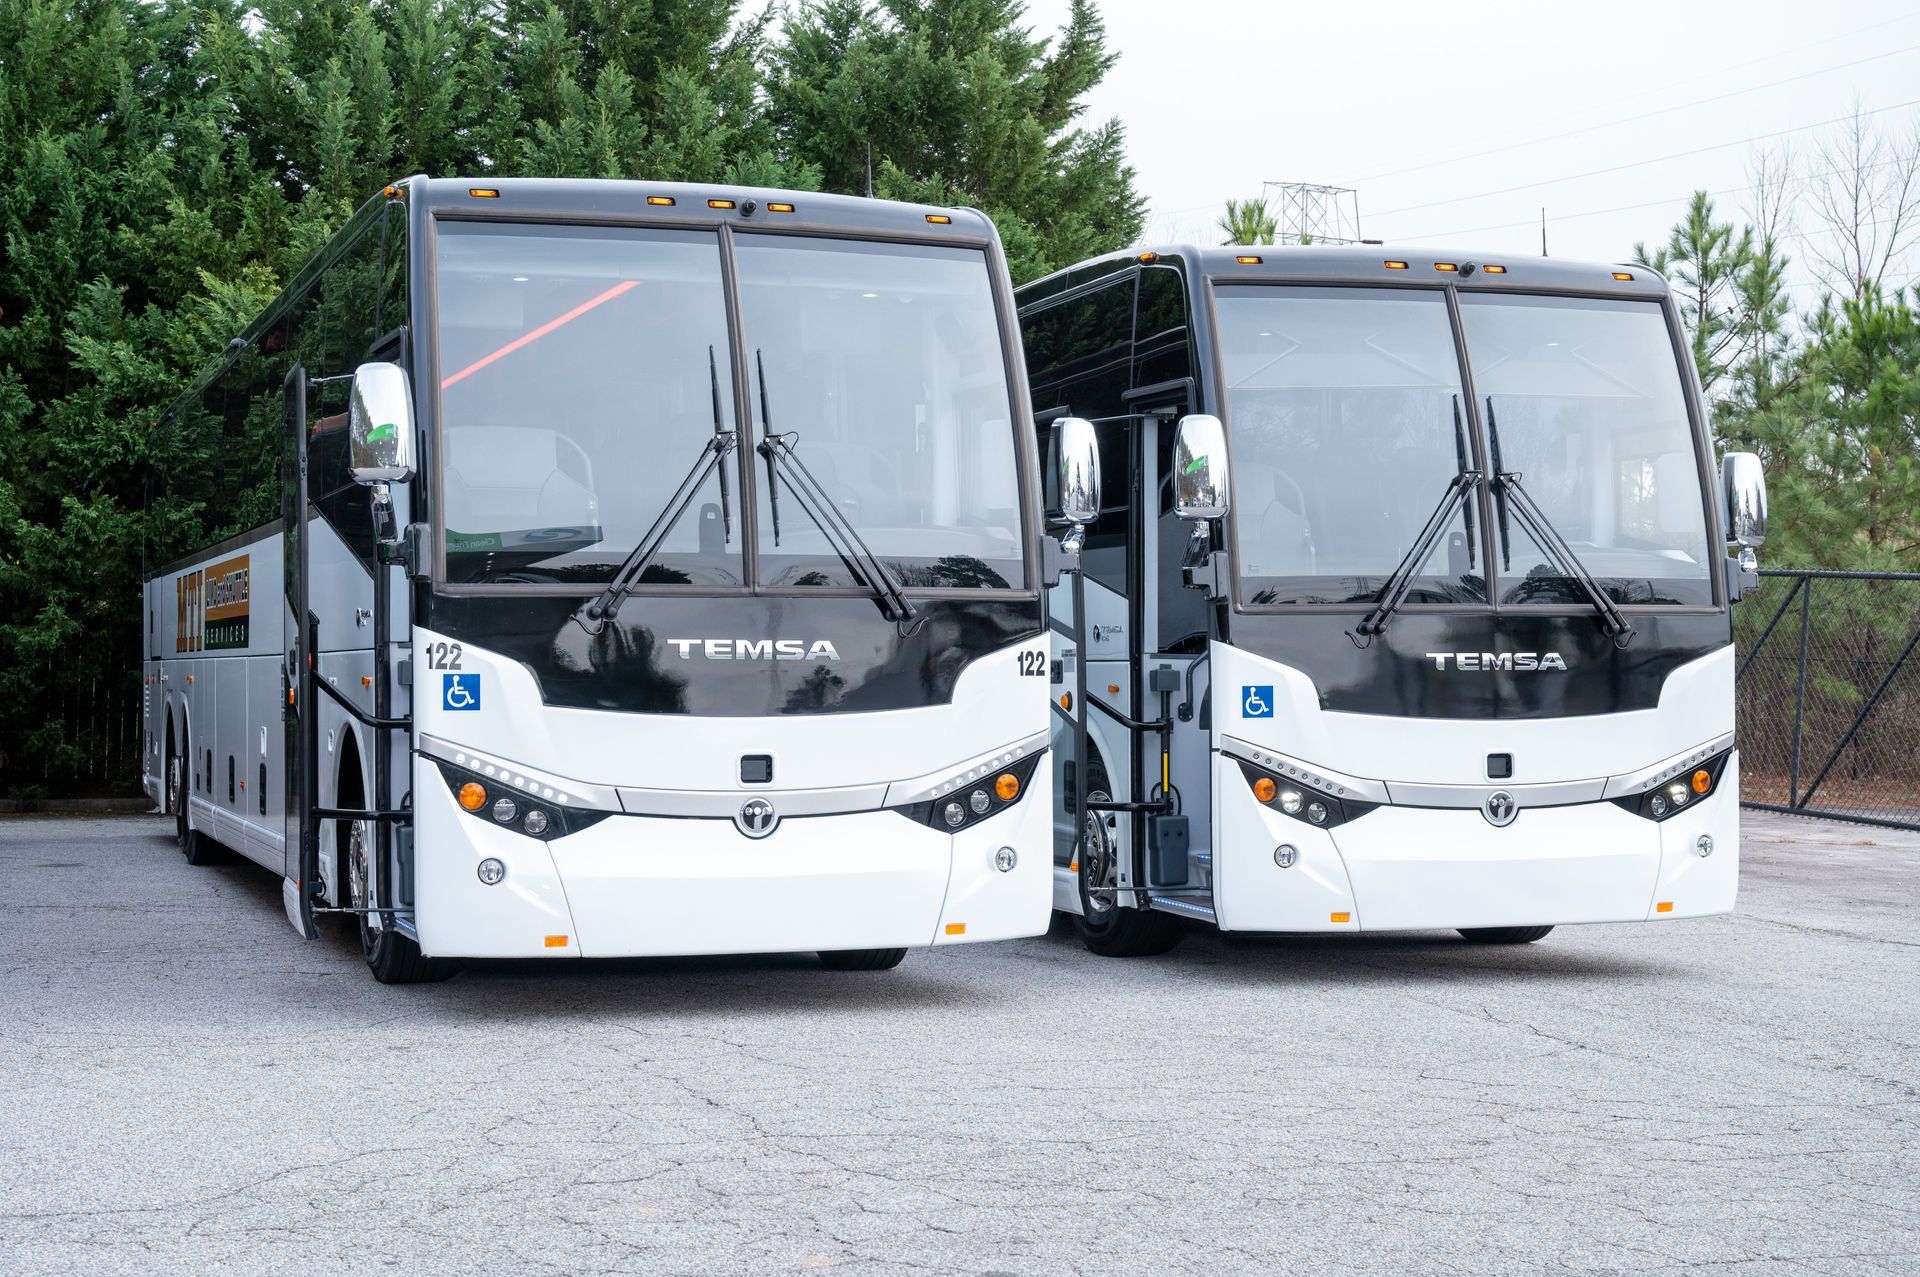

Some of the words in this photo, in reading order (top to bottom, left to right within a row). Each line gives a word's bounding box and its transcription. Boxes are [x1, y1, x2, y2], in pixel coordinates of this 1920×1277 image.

[206, 624, 244, 644] SERVICES
[426, 642, 462, 671] 122
[667, 639, 841, 661] TEMSA
[1017, 651, 1046, 677] 122
[1425, 652, 1568, 671] TEMSA
